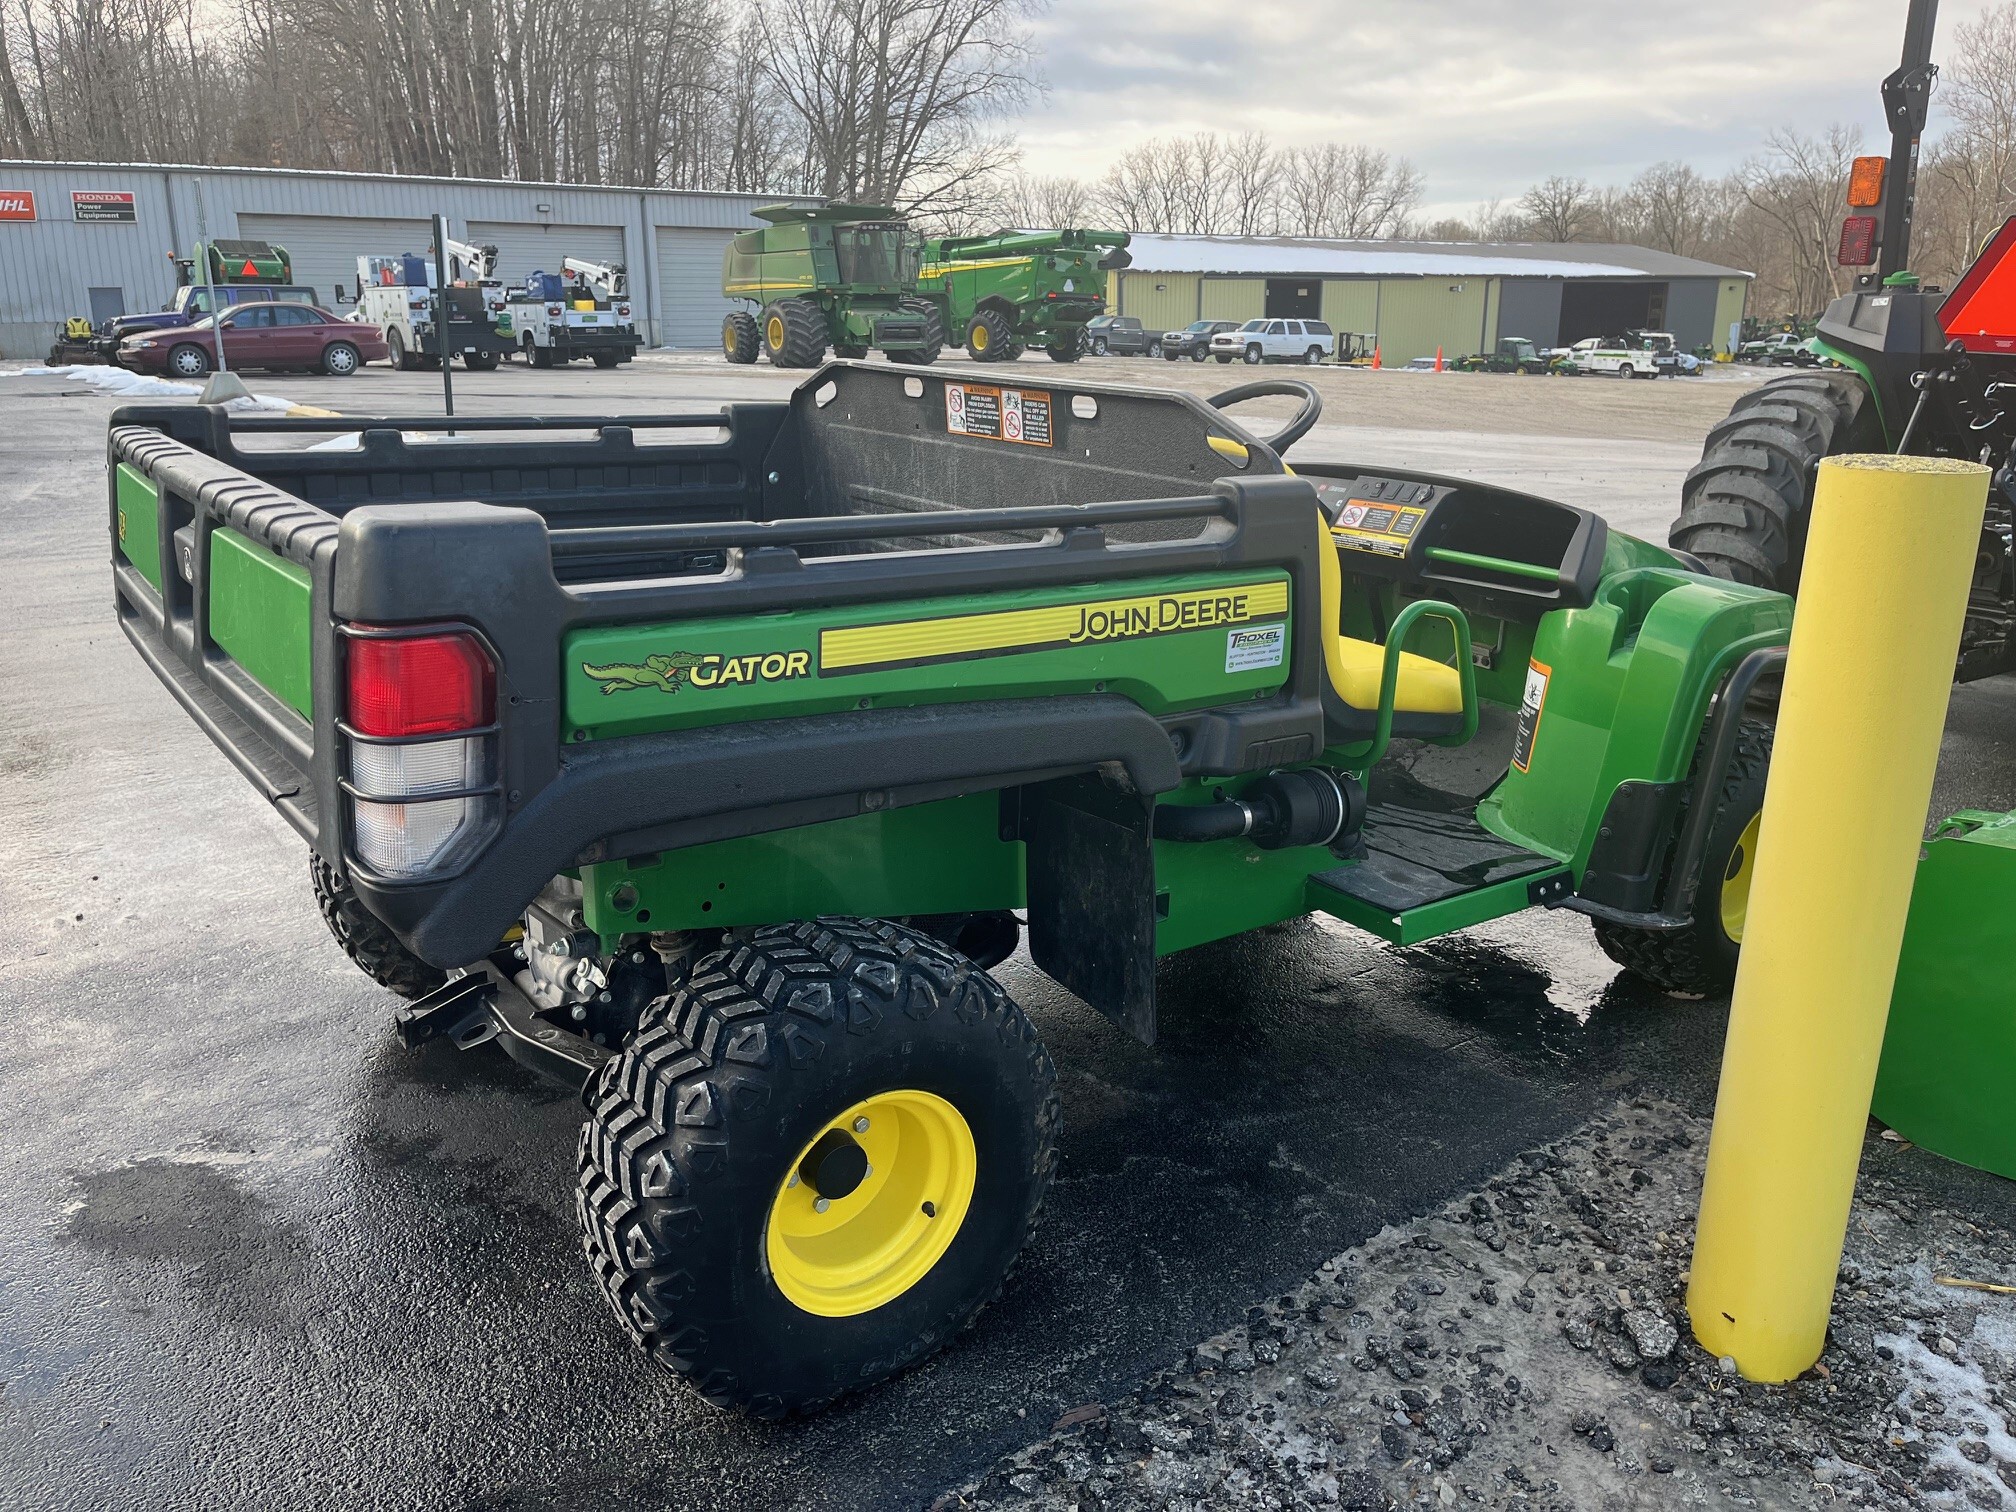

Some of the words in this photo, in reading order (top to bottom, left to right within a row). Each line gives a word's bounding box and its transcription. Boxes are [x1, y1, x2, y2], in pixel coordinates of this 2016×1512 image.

[1069, 606, 1151, 639] JOHN
[1158, 594, 1249, 628] DEERE
[1231, 631, 1281, 649] TROXEL
[689, 651, 811, 687] GATOR
